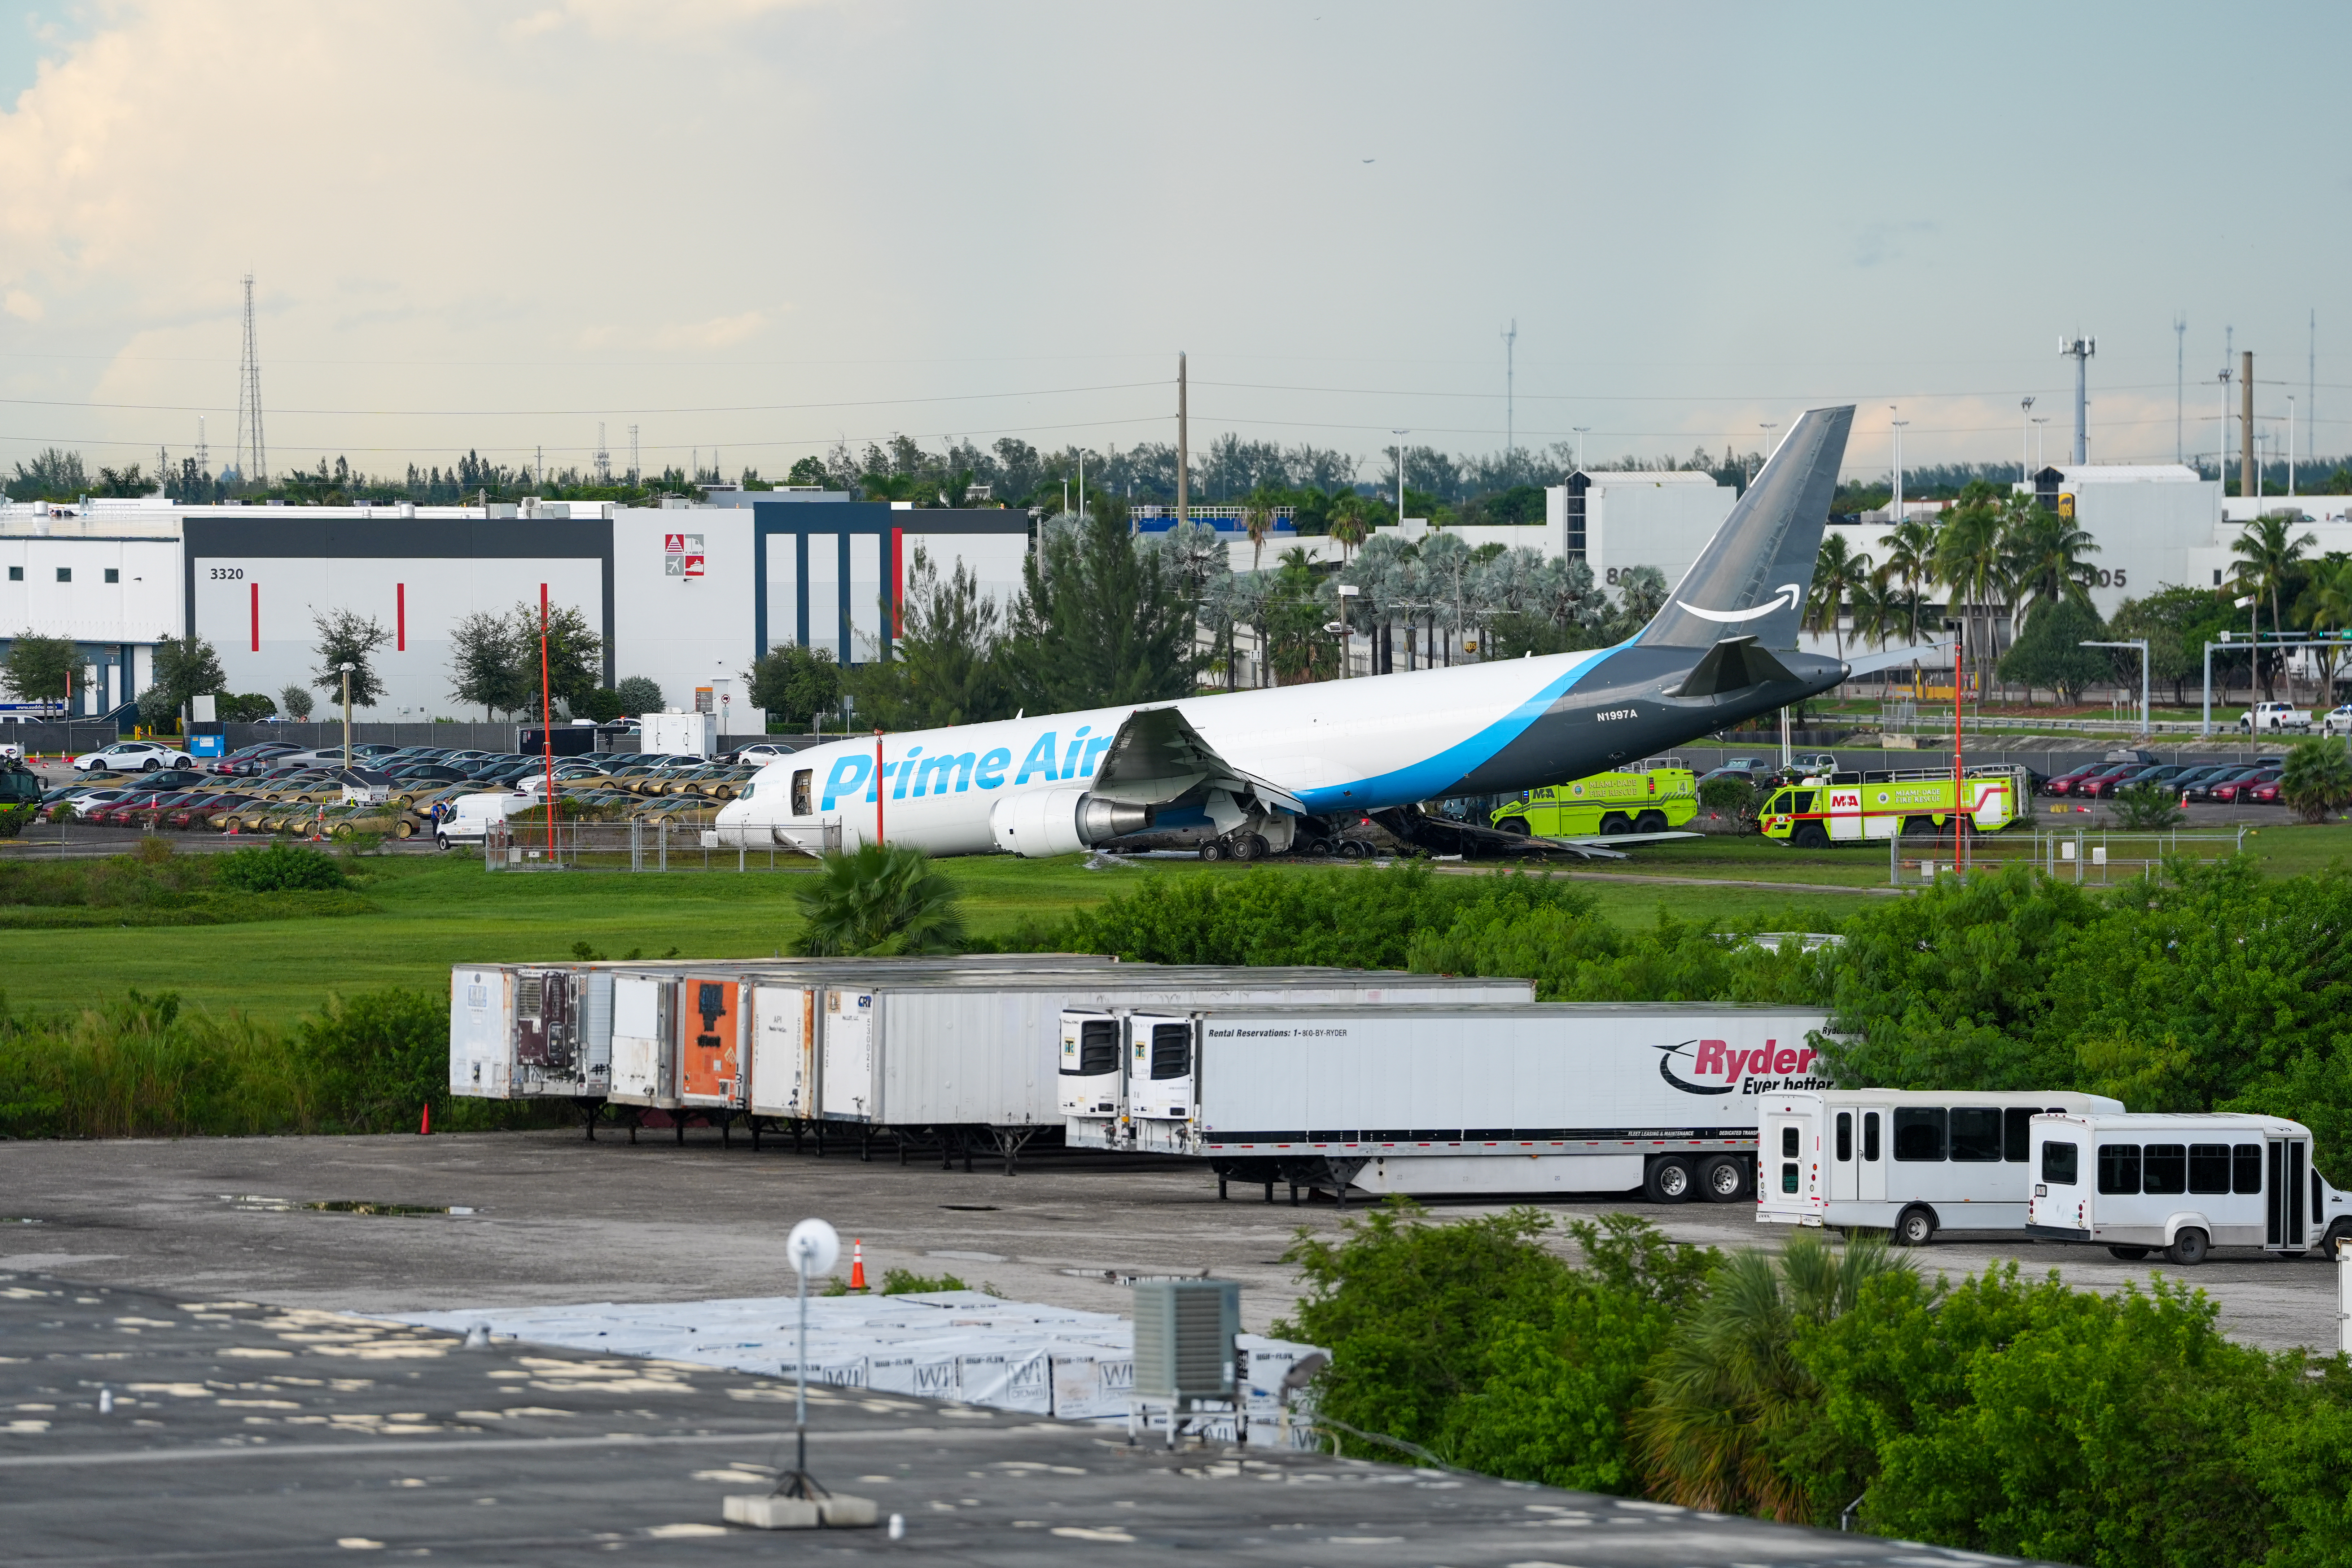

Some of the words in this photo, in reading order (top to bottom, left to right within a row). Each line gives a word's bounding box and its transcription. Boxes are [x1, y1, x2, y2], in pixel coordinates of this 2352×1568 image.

[2059, 503, 2071, 520] ups
[211, 568, 243, 579] 3320
[1464, 641, 1476, 652] ups
[1597, 709, 1638, 722] N1997A
[821, 746, 1011, 811] Prime
[1015, 726, 1114, 785] Air
[1589, 779, 1637, 788] MIAMI-DADE
[1679, 782, 1686, 793] 4
[1694, 1039, 1817, 1083] Ryder
[1742, 1077, 1780, 1094] Ever
[1783, 1077, 1834, 1090] better
